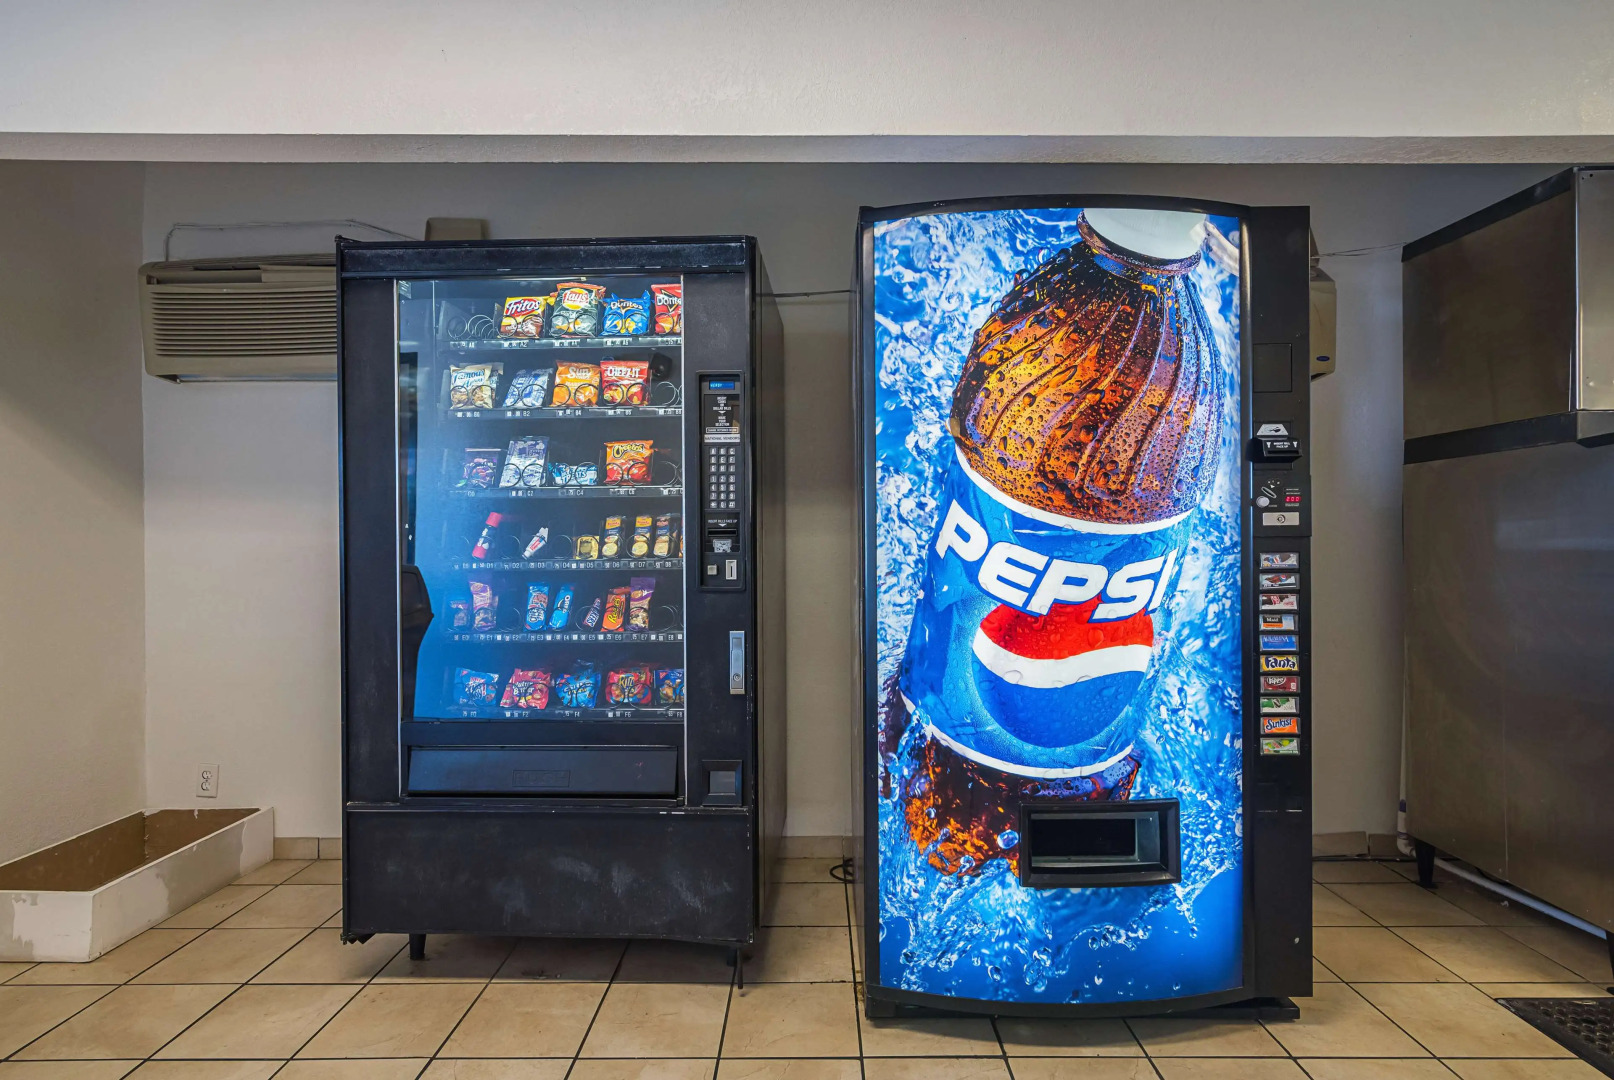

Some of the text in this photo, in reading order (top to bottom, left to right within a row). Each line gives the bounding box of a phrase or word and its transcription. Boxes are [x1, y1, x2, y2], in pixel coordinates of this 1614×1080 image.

[506, 299, 541, 315] Fritos
[611, 301, 643, 310] Doritos
[612, 443, 644, 459] Cheetos
[936, 499, 1179, 620] PEPSI
[1264, 656, 1296, 669] Fanta
[1266, 718, 1292, 730] Sunkist
